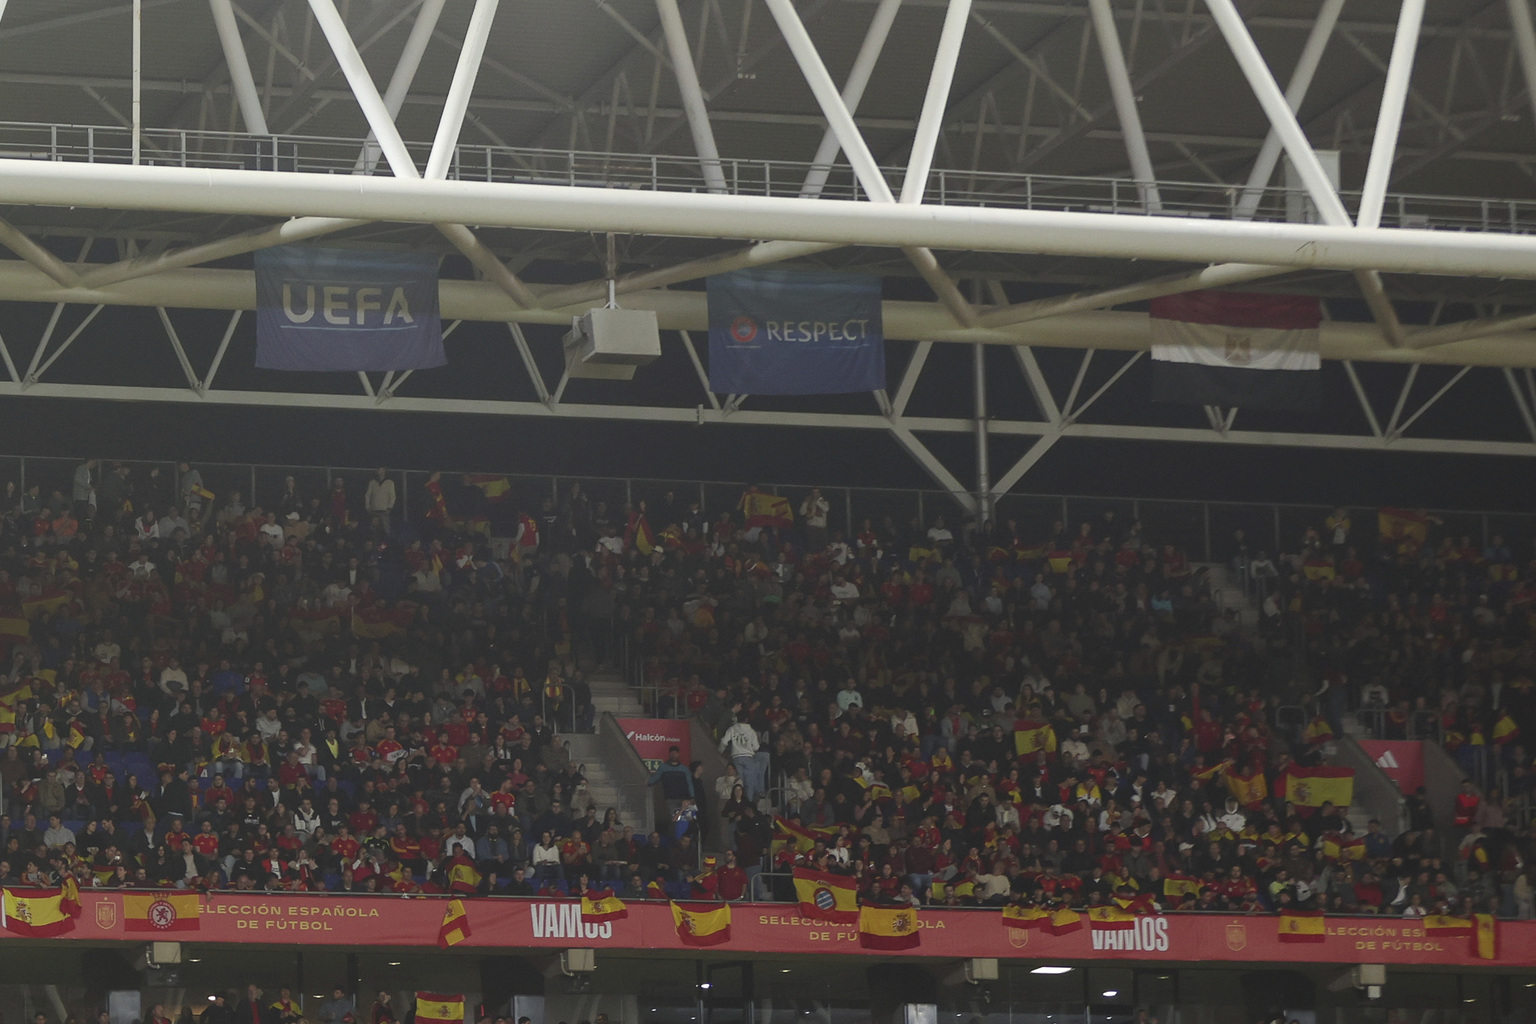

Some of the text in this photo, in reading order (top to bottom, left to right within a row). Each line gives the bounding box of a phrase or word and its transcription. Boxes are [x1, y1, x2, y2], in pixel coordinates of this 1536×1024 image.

[282, 283, 414, 325] UEFA
[766, 319, 869, 342] RESPECT
[635, 731, 667, 742] Halcón
[198, 903, 379, 918] ELECCIÓN ESPAÑOLA
[237, 917, 333, 930] DE FÚTBOL
[809, 931, 831, 941] DE
[1327, 926, 1396, 937] LECCIÓN
[1355, 939, 1445, 951] DE FÚTBOL
